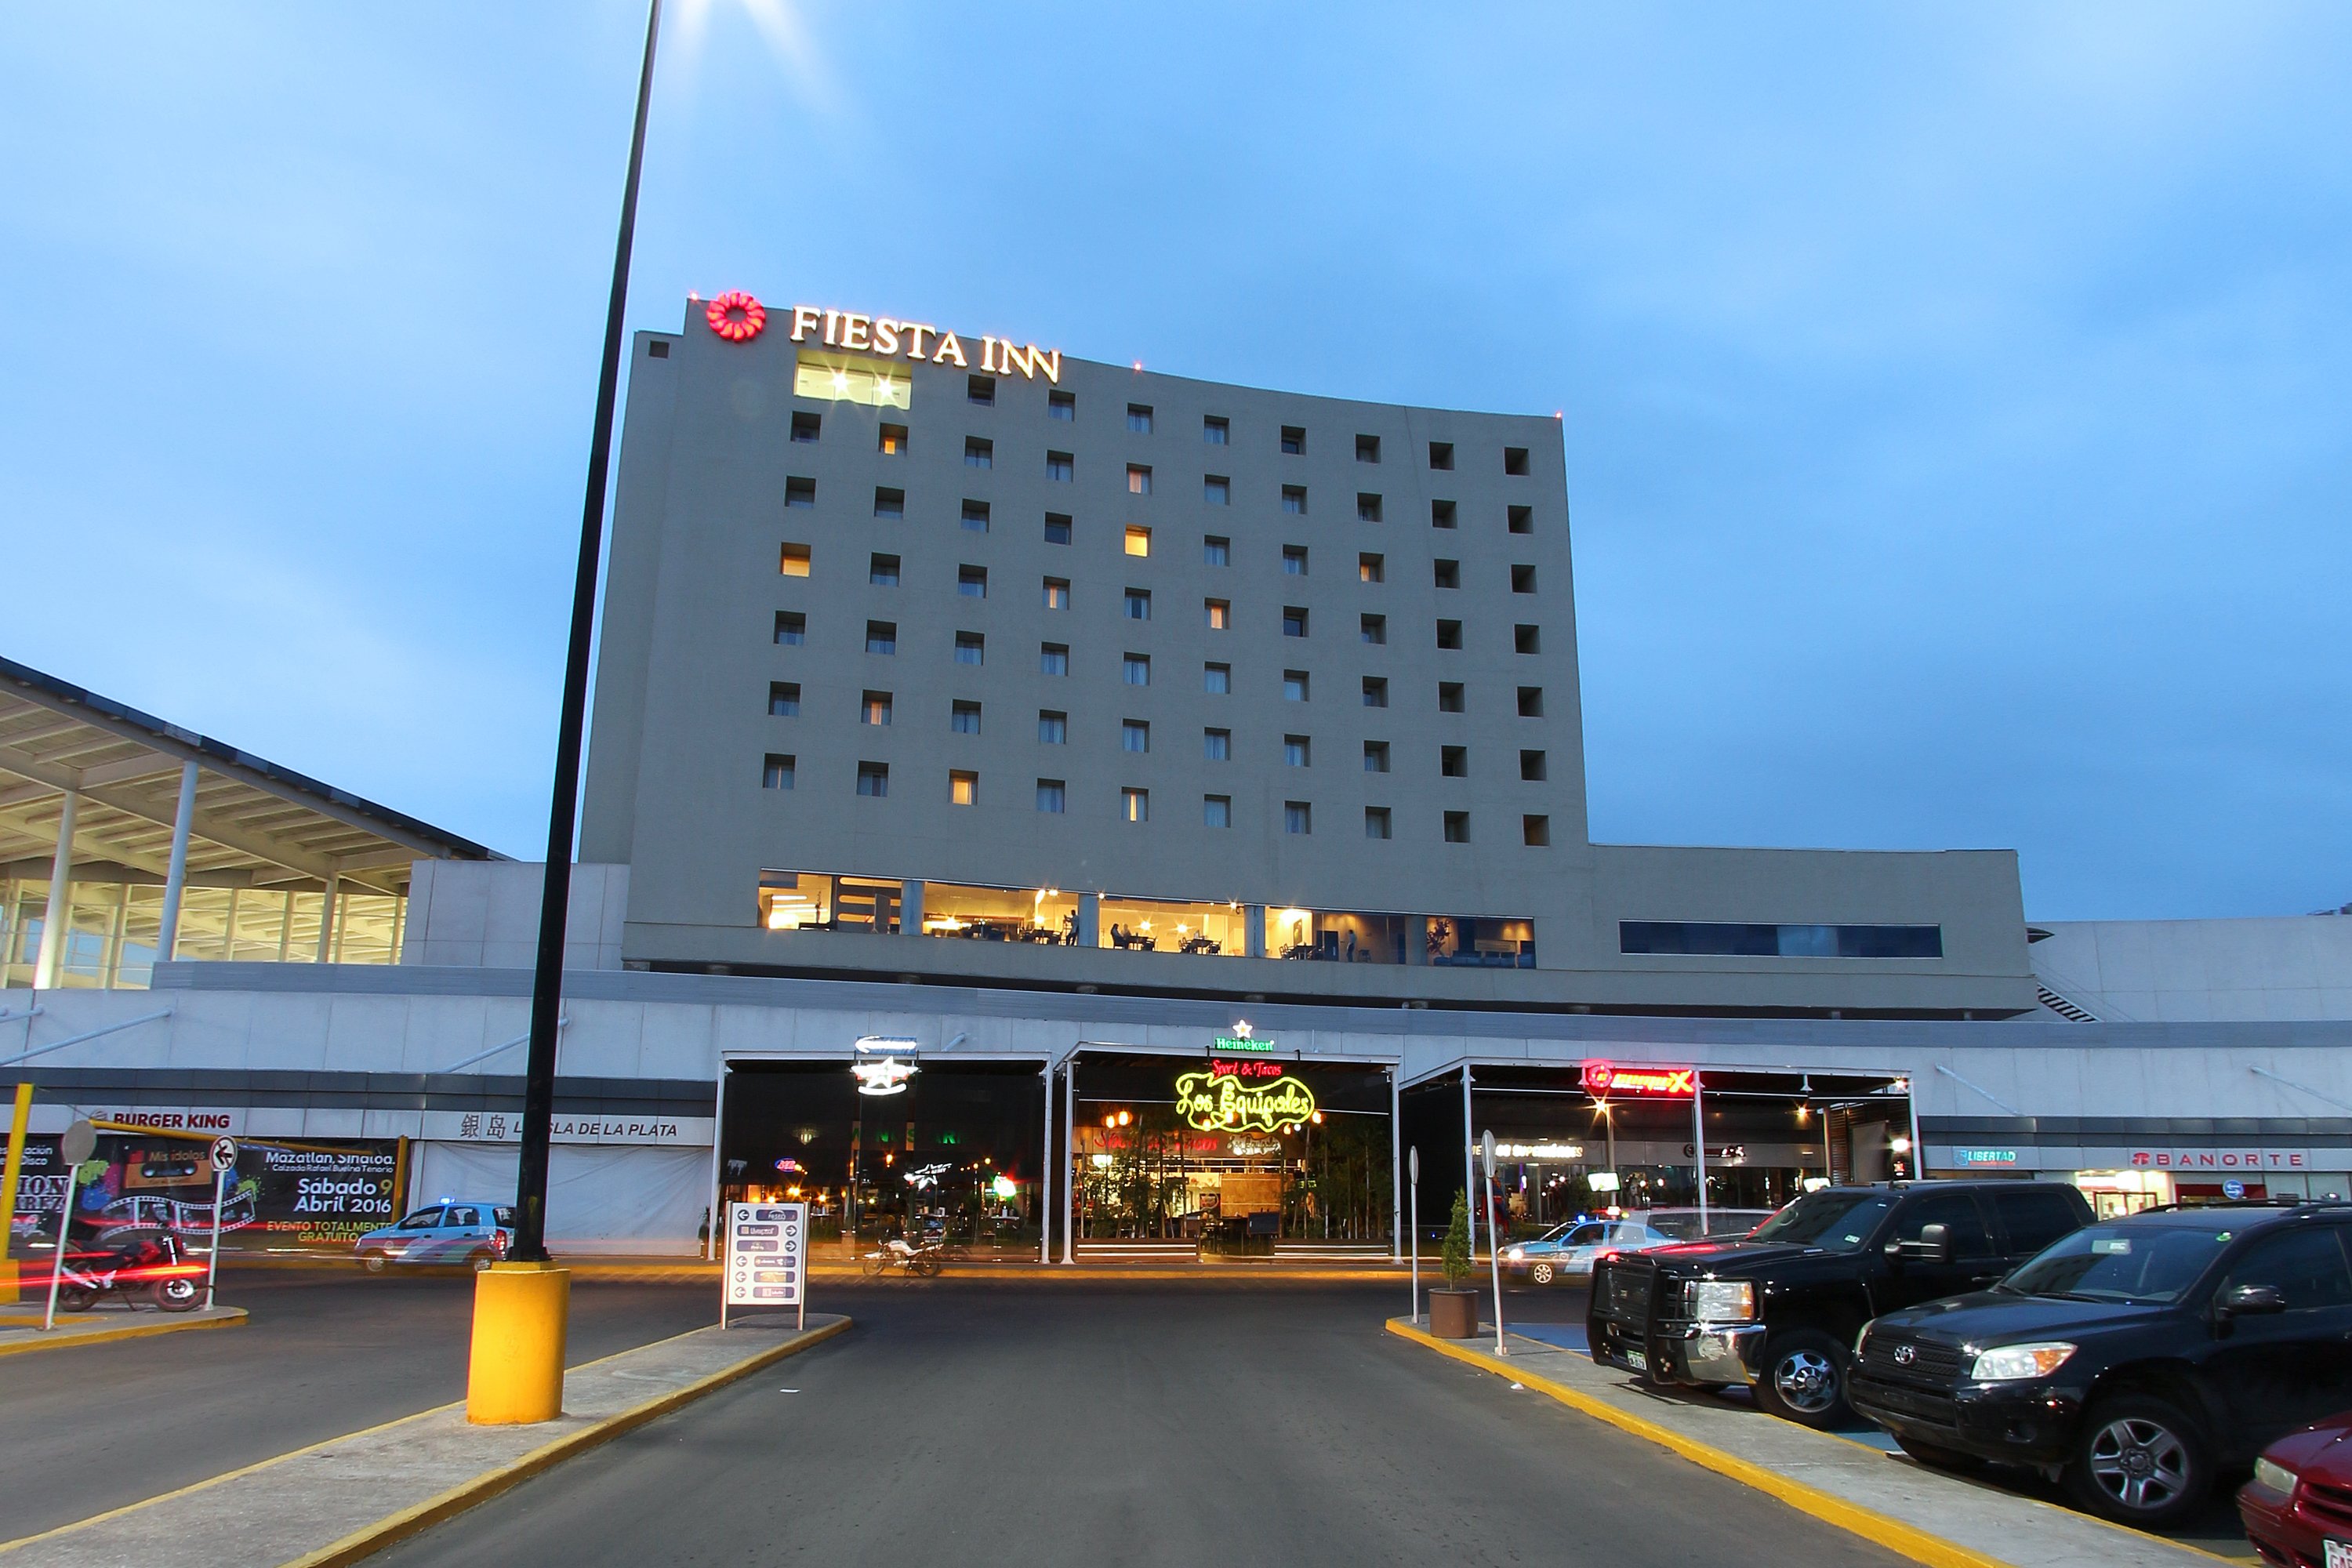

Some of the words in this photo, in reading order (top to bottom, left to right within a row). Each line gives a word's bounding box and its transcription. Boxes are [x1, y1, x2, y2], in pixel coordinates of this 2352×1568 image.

[790, 306, 967, 367] FIESTA
[980, 336, 1062, 384] INN
[1215, 1037, 1273, 1051] Heineken
[1213, 1059, 1239, 1077] Sport
[1253, 1062, 1282, 1077] Tacos
[1176, 1080, 1213, 1114] Los
[114, 1112, 183, 1127] BURGER
[187, 1114, 230, 1129] KING
[549, 1122, 573, 1134] LA
[578, 1123, 600, 1135] DE
[603, 1123, 624, 1136] LA
[628, 1124, 677, 1137] PLATA
[1968, 1151, 2016, 1161] LIBERTAD
[2157, 1154, 2303, 1167] BANORTE
[297, 1178, 376, 1195] Sábado
[380, 1179, 393, 1195] 9
[293, 1196, 345, 1212] Abril
[350, 1199, 392, 1213] 2016
[266, 1221, 311, 1231] EVENTO
[298, 1232, 359, 1242] GRATUITO
